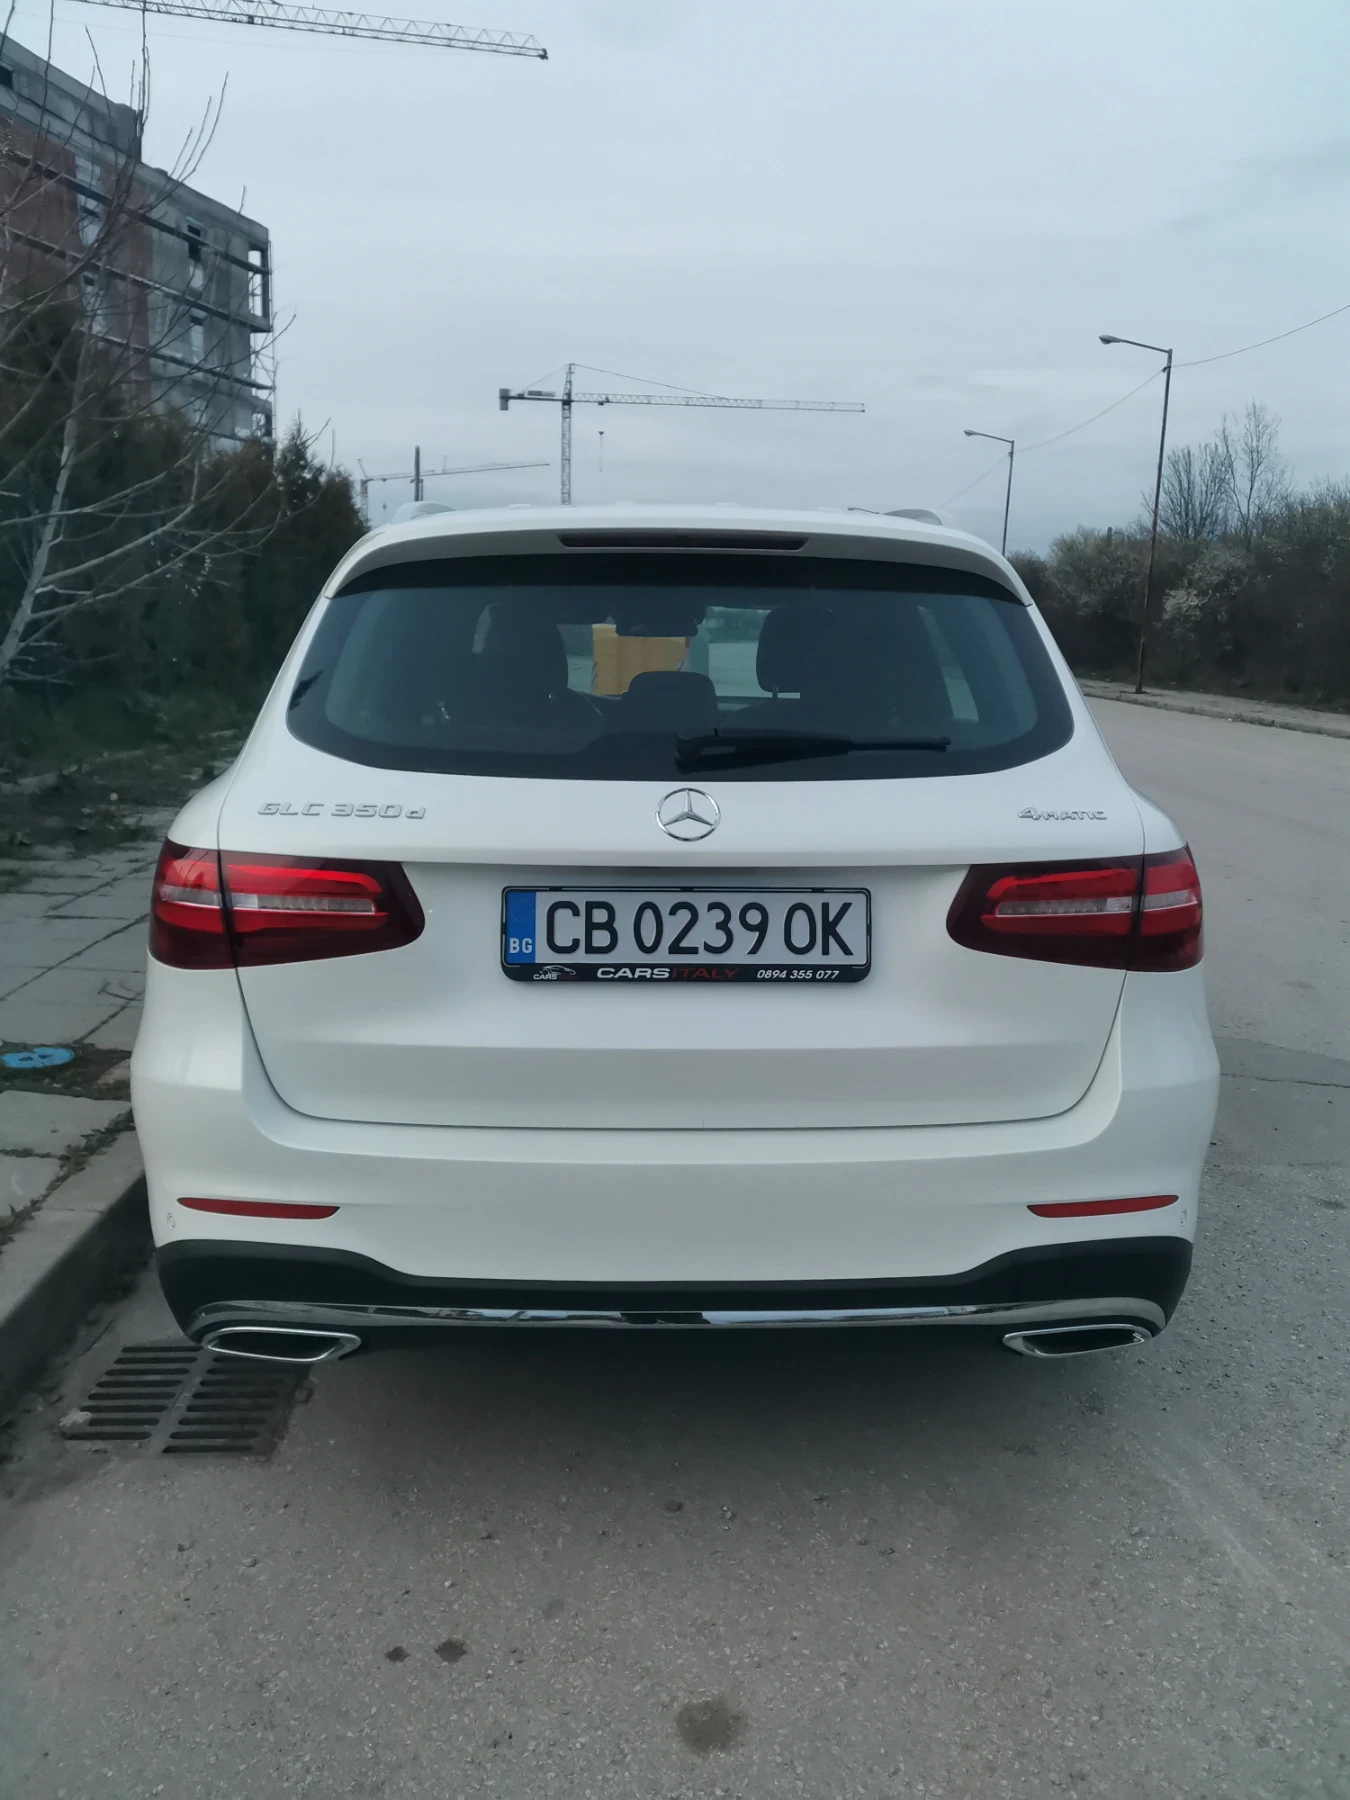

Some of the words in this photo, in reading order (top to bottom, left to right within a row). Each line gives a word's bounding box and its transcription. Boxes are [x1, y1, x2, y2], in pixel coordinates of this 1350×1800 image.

[257, 802, 325, 816] GLC
[1018, 806, 1108, 821] 4MATIC
[546, 900, 619, 954] CB
[633, 901, 769, 955] 0239
[509, 938, 533, 954] BG
[756, 969, 787, 979] 0894
[789, 970, 813, 979] 355
[815, 970, 840, 980] 077
